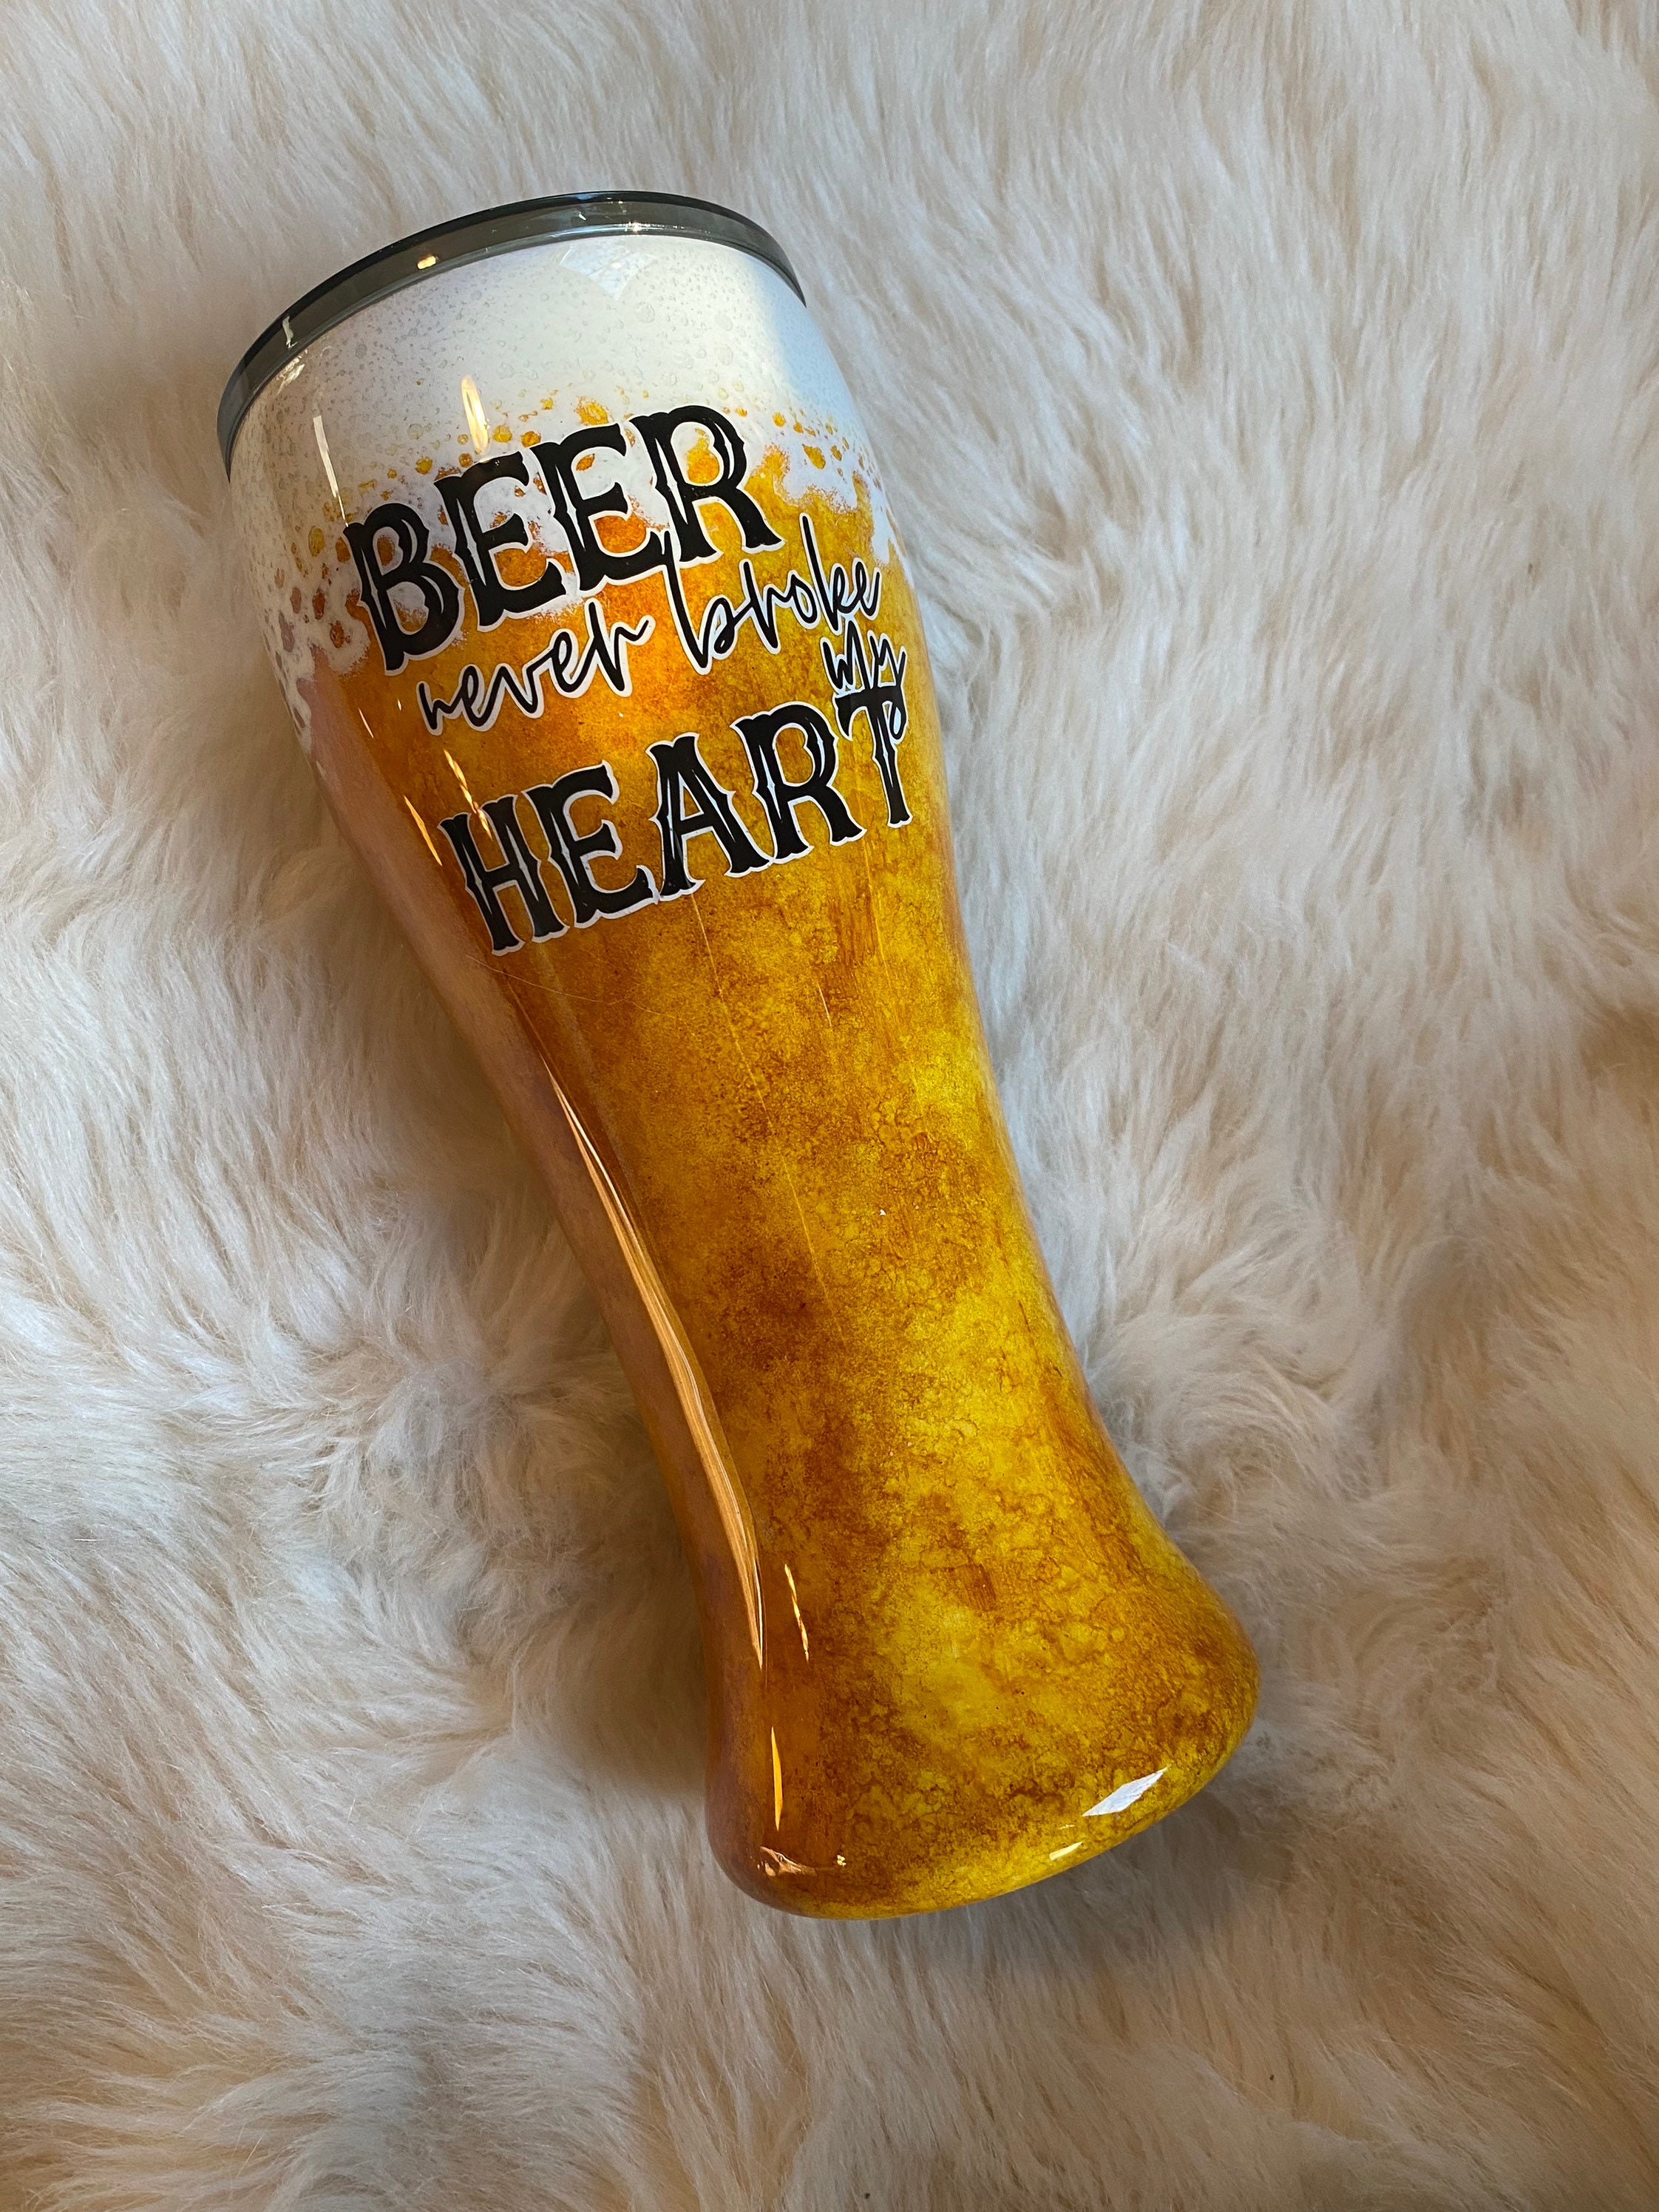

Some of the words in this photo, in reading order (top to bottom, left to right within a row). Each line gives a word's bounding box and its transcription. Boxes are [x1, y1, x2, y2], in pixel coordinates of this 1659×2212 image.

[343, 406, 778, 671] BEER
[418, 602, 649, 730] never
[662, 515, 880, 667] broke
[442, 680, 911, 951] HEART
